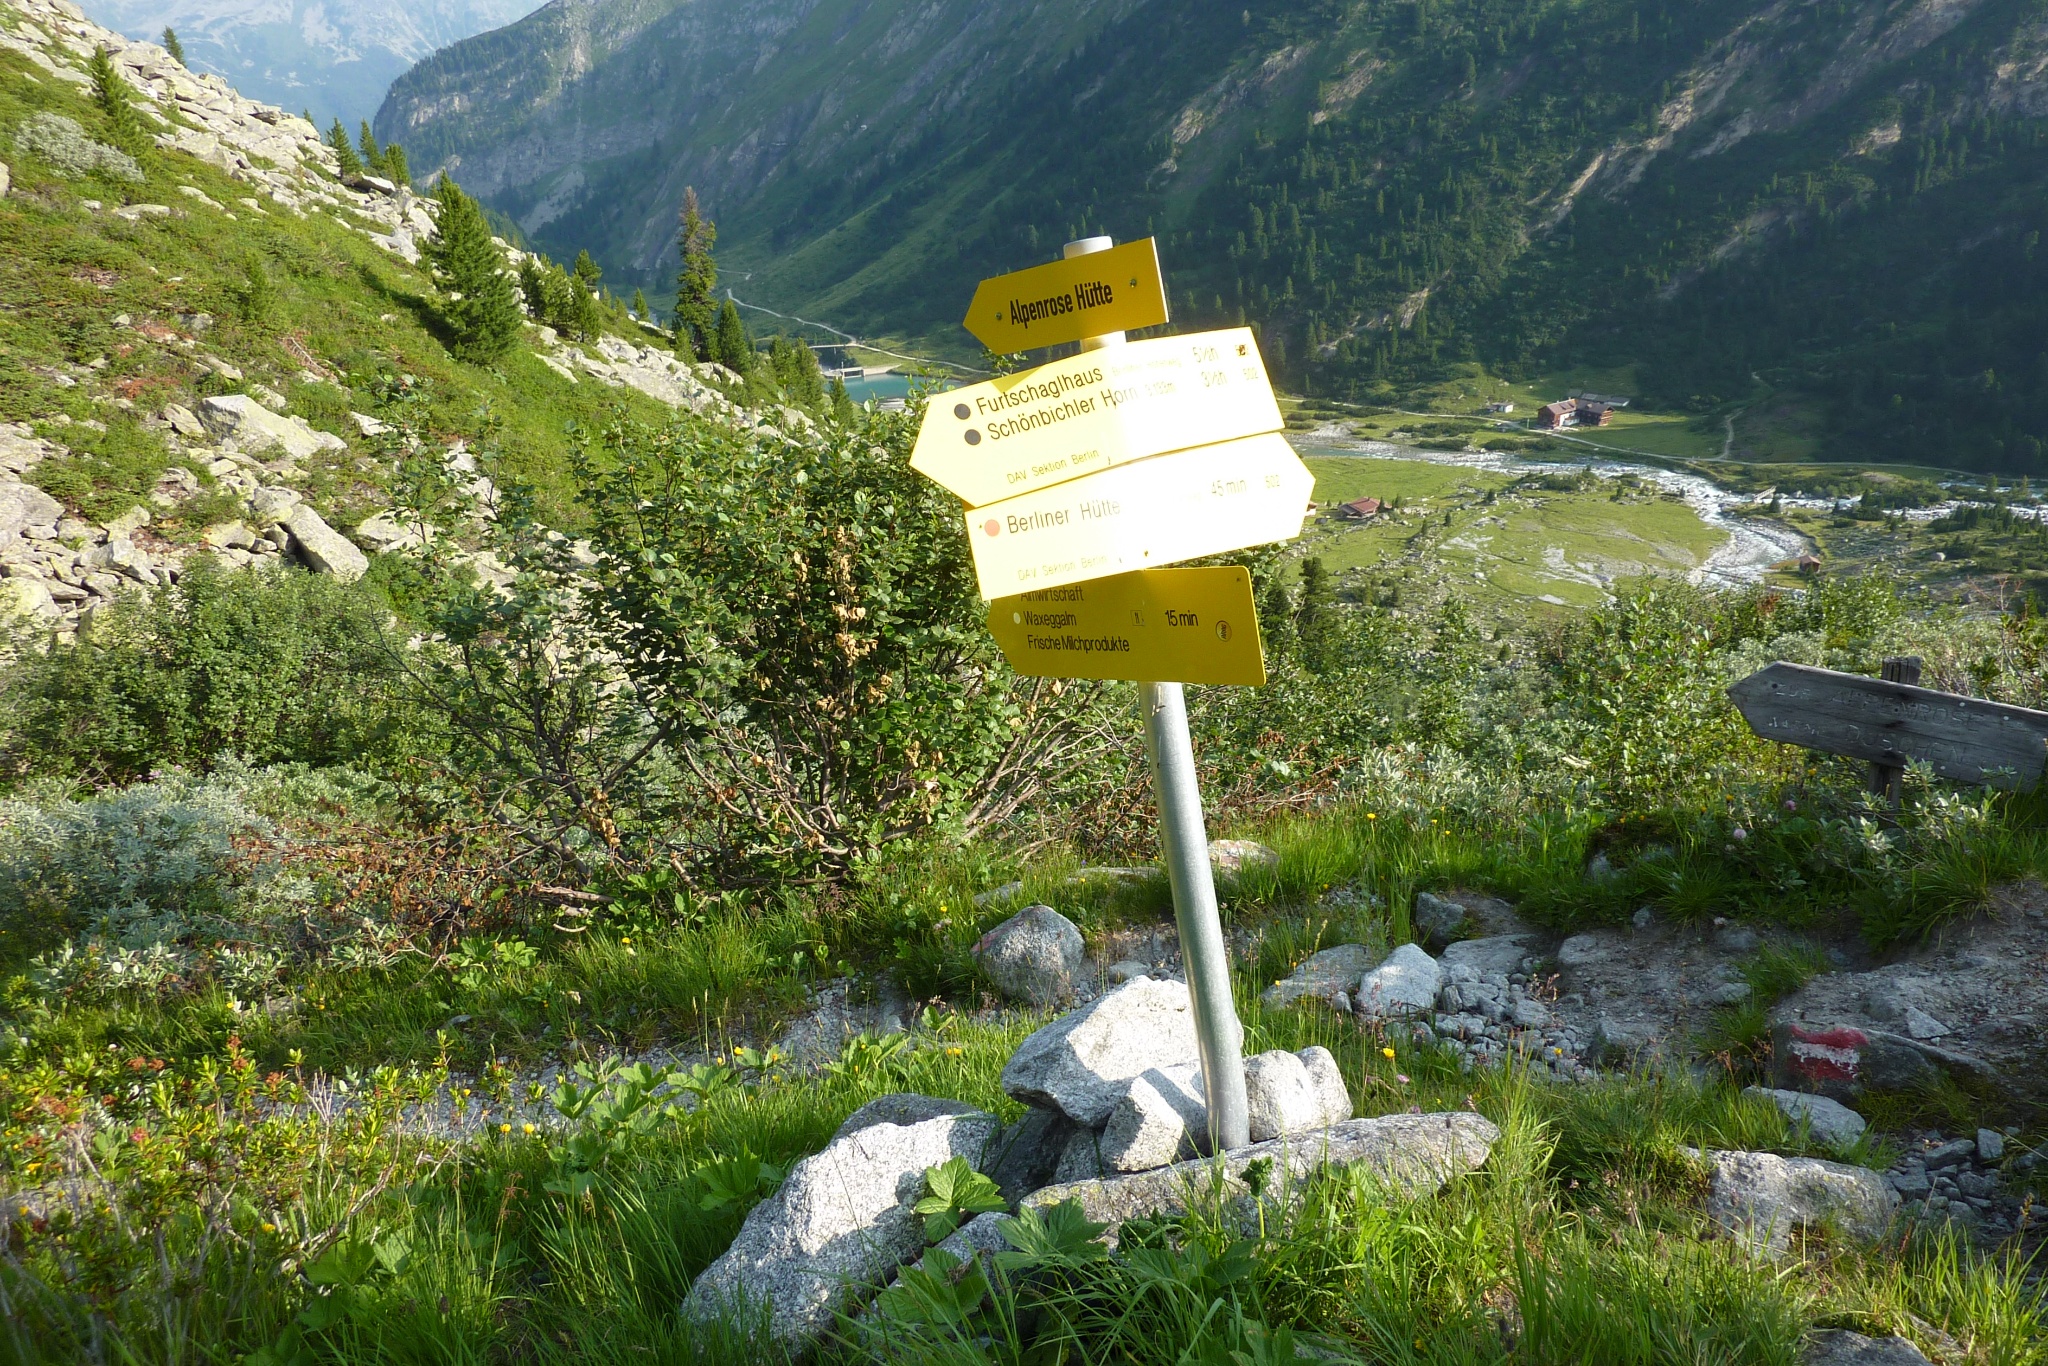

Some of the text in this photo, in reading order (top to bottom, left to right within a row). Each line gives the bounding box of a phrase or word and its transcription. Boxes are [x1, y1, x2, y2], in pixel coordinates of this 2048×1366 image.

[1009, 280, 1114, 329] Alpenrose Hütte
[975, 366, 1104, 416] Furtschaglhaus
[987, 396, 1096, 441] Schönbichler
[1100, 384, 1139, 408] Horn
[1006, 448, 1100, 485] DAV Sektion Berlin
[1006, 506, 1070, 535] Berliner
[1079, 498, 1121, 521] Hütte
[1226, 477, 1247, 495] min
[1017, 555, 1107, 581] DAV Sektion Berlin
[1023, 610, 1199, 630] Waxeggalm 15 min
